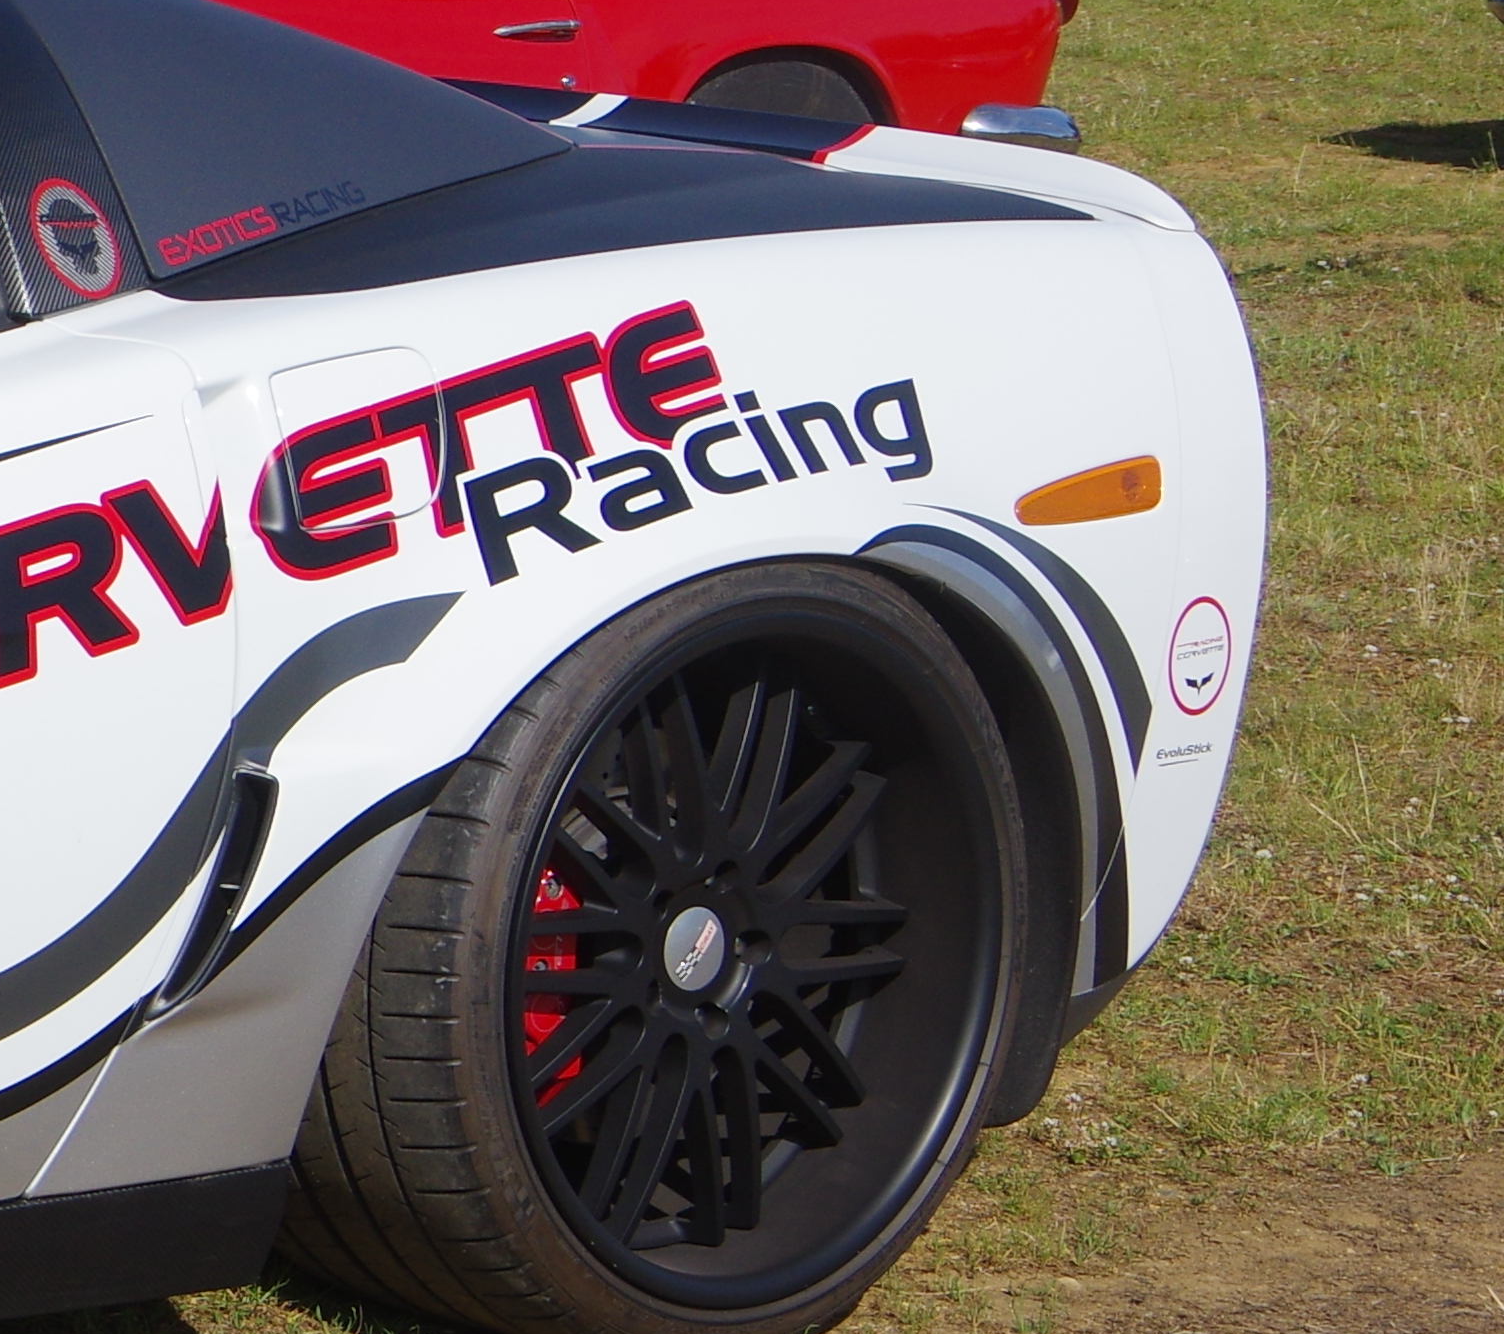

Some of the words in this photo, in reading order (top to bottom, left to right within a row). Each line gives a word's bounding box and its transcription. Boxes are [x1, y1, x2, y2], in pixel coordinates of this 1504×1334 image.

[157, 204, 279, 266] EXOTICS
[272, 179, 366, 227] RACING
[457, 378, 934, 586] Racing
[1176, 644, 1225, 661] CORVETTE
